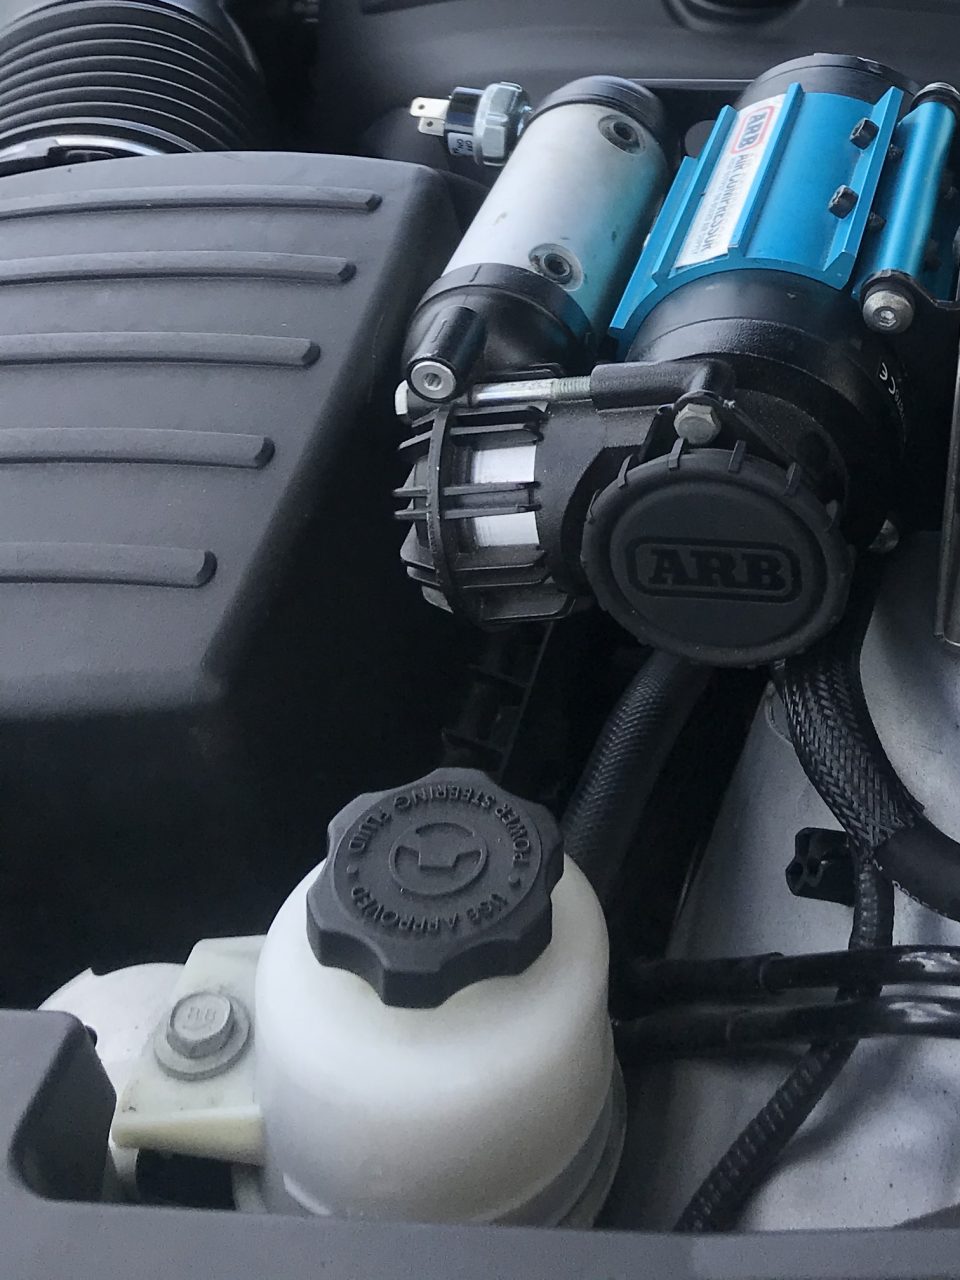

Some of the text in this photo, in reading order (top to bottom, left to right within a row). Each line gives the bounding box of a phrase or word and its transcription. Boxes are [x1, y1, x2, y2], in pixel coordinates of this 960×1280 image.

[737, 111, 768, 149] ARB
[647, 547, 787, 592] ARB
[348, 784, 531, 867] POWER STEERING FLUID
